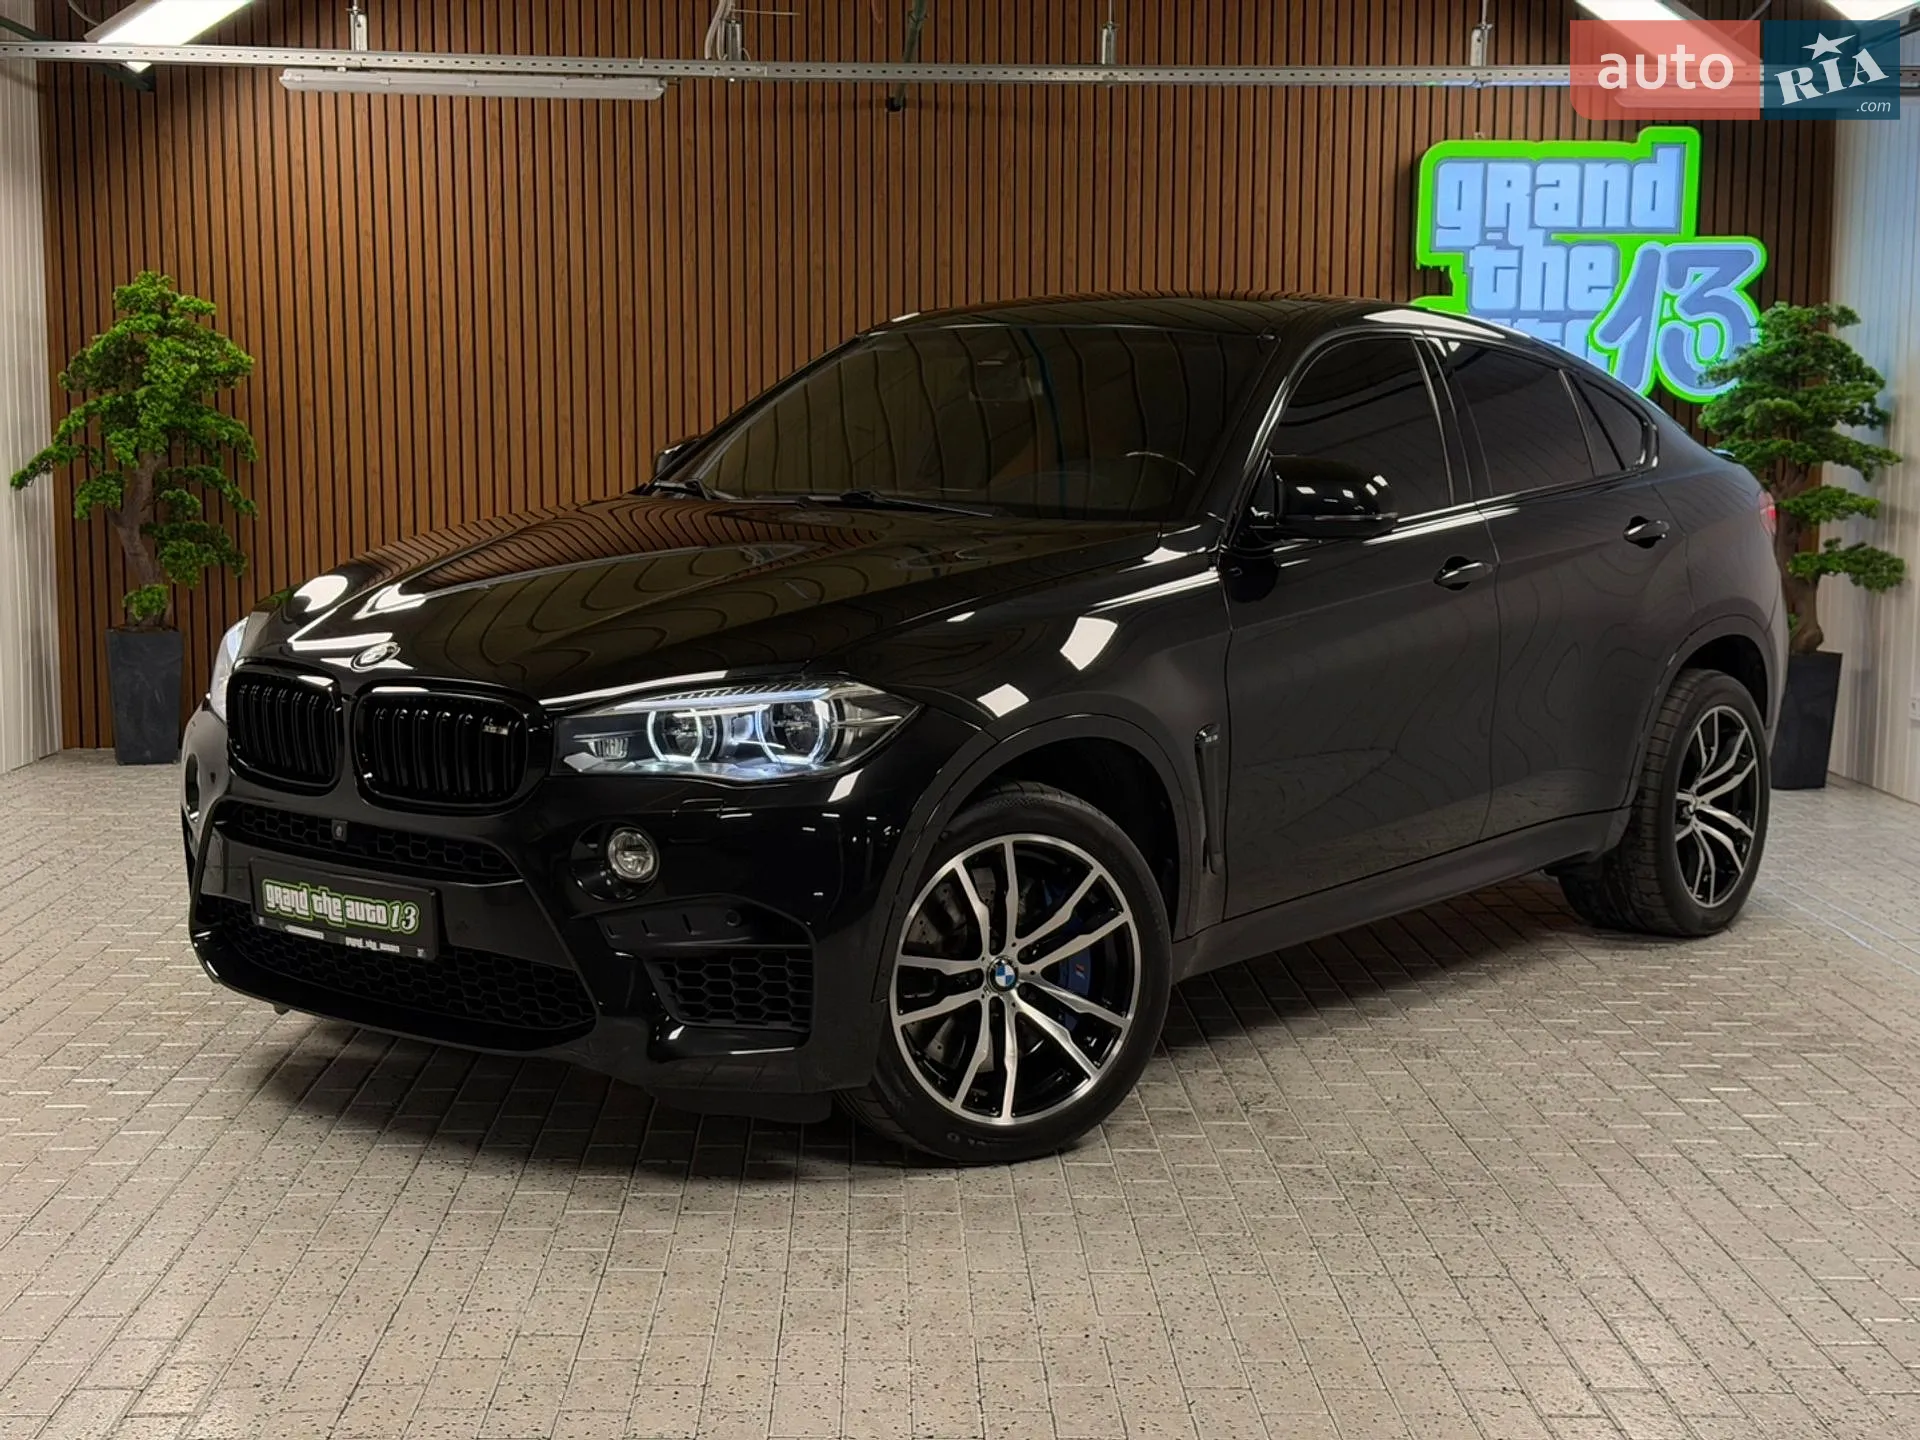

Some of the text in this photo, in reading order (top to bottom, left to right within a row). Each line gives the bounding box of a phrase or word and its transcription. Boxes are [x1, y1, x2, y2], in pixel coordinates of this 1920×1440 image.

[1469, 229, 1618, 311] the
[1594, 242, 1764, 392] 13
[311, 890, 344, 923] the
[345, 899, 387, 925] auto
[391, 904, 416, 930] 13
